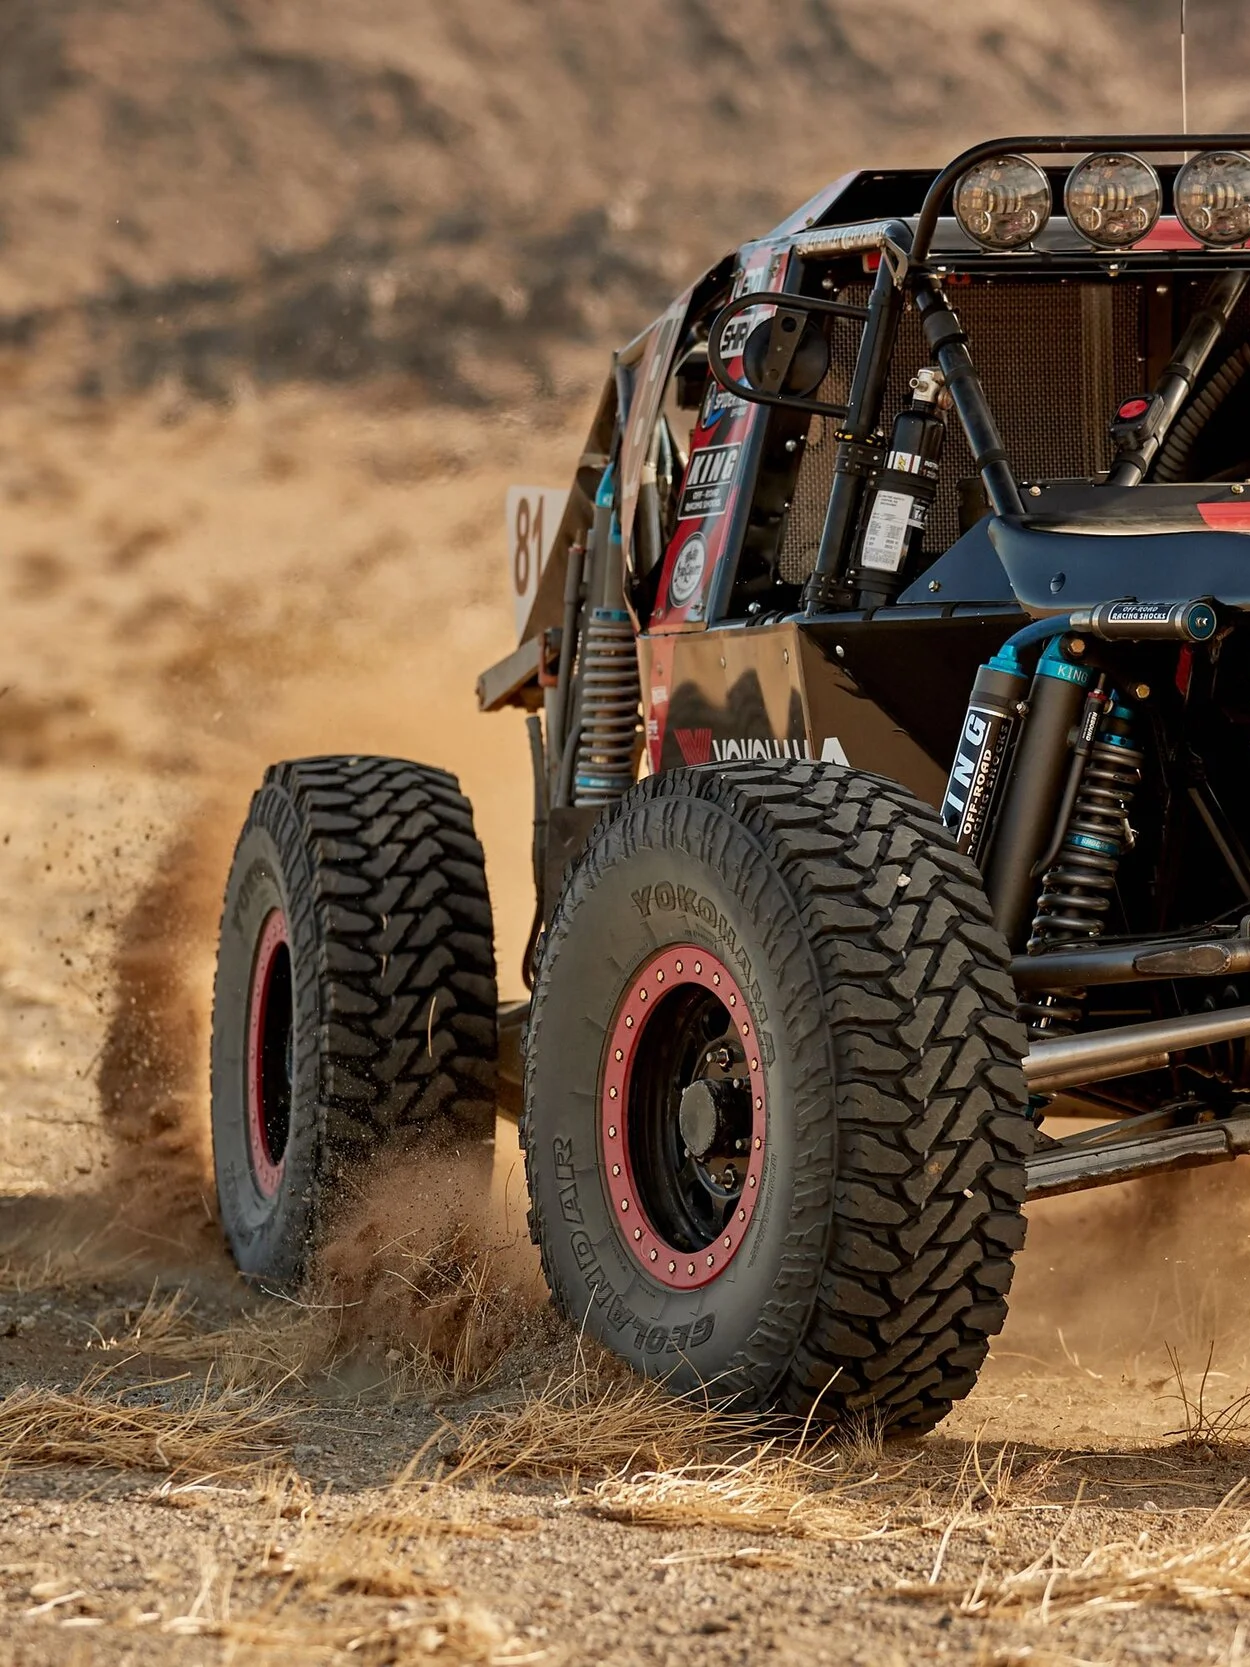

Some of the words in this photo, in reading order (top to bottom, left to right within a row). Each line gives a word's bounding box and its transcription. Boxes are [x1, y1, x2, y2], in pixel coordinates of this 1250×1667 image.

[687, 449, 738, 486] KING
[515, 494, 544, 597] 81
[1111, 612, 1138, 620] RACING
[1139, 612, 1167, 620] SHOCKS
[1057, 664, 1089, 683] KING
[945, 713, 987, 813] ING
[1085, 711, 1098, 742] REBOUND
[963, 749, 993, 835] OFF-ROAD
[631, 880, 777, 1068] YOKOHAMA
[552, 1136, 717, 1355] GEOLANDAR
